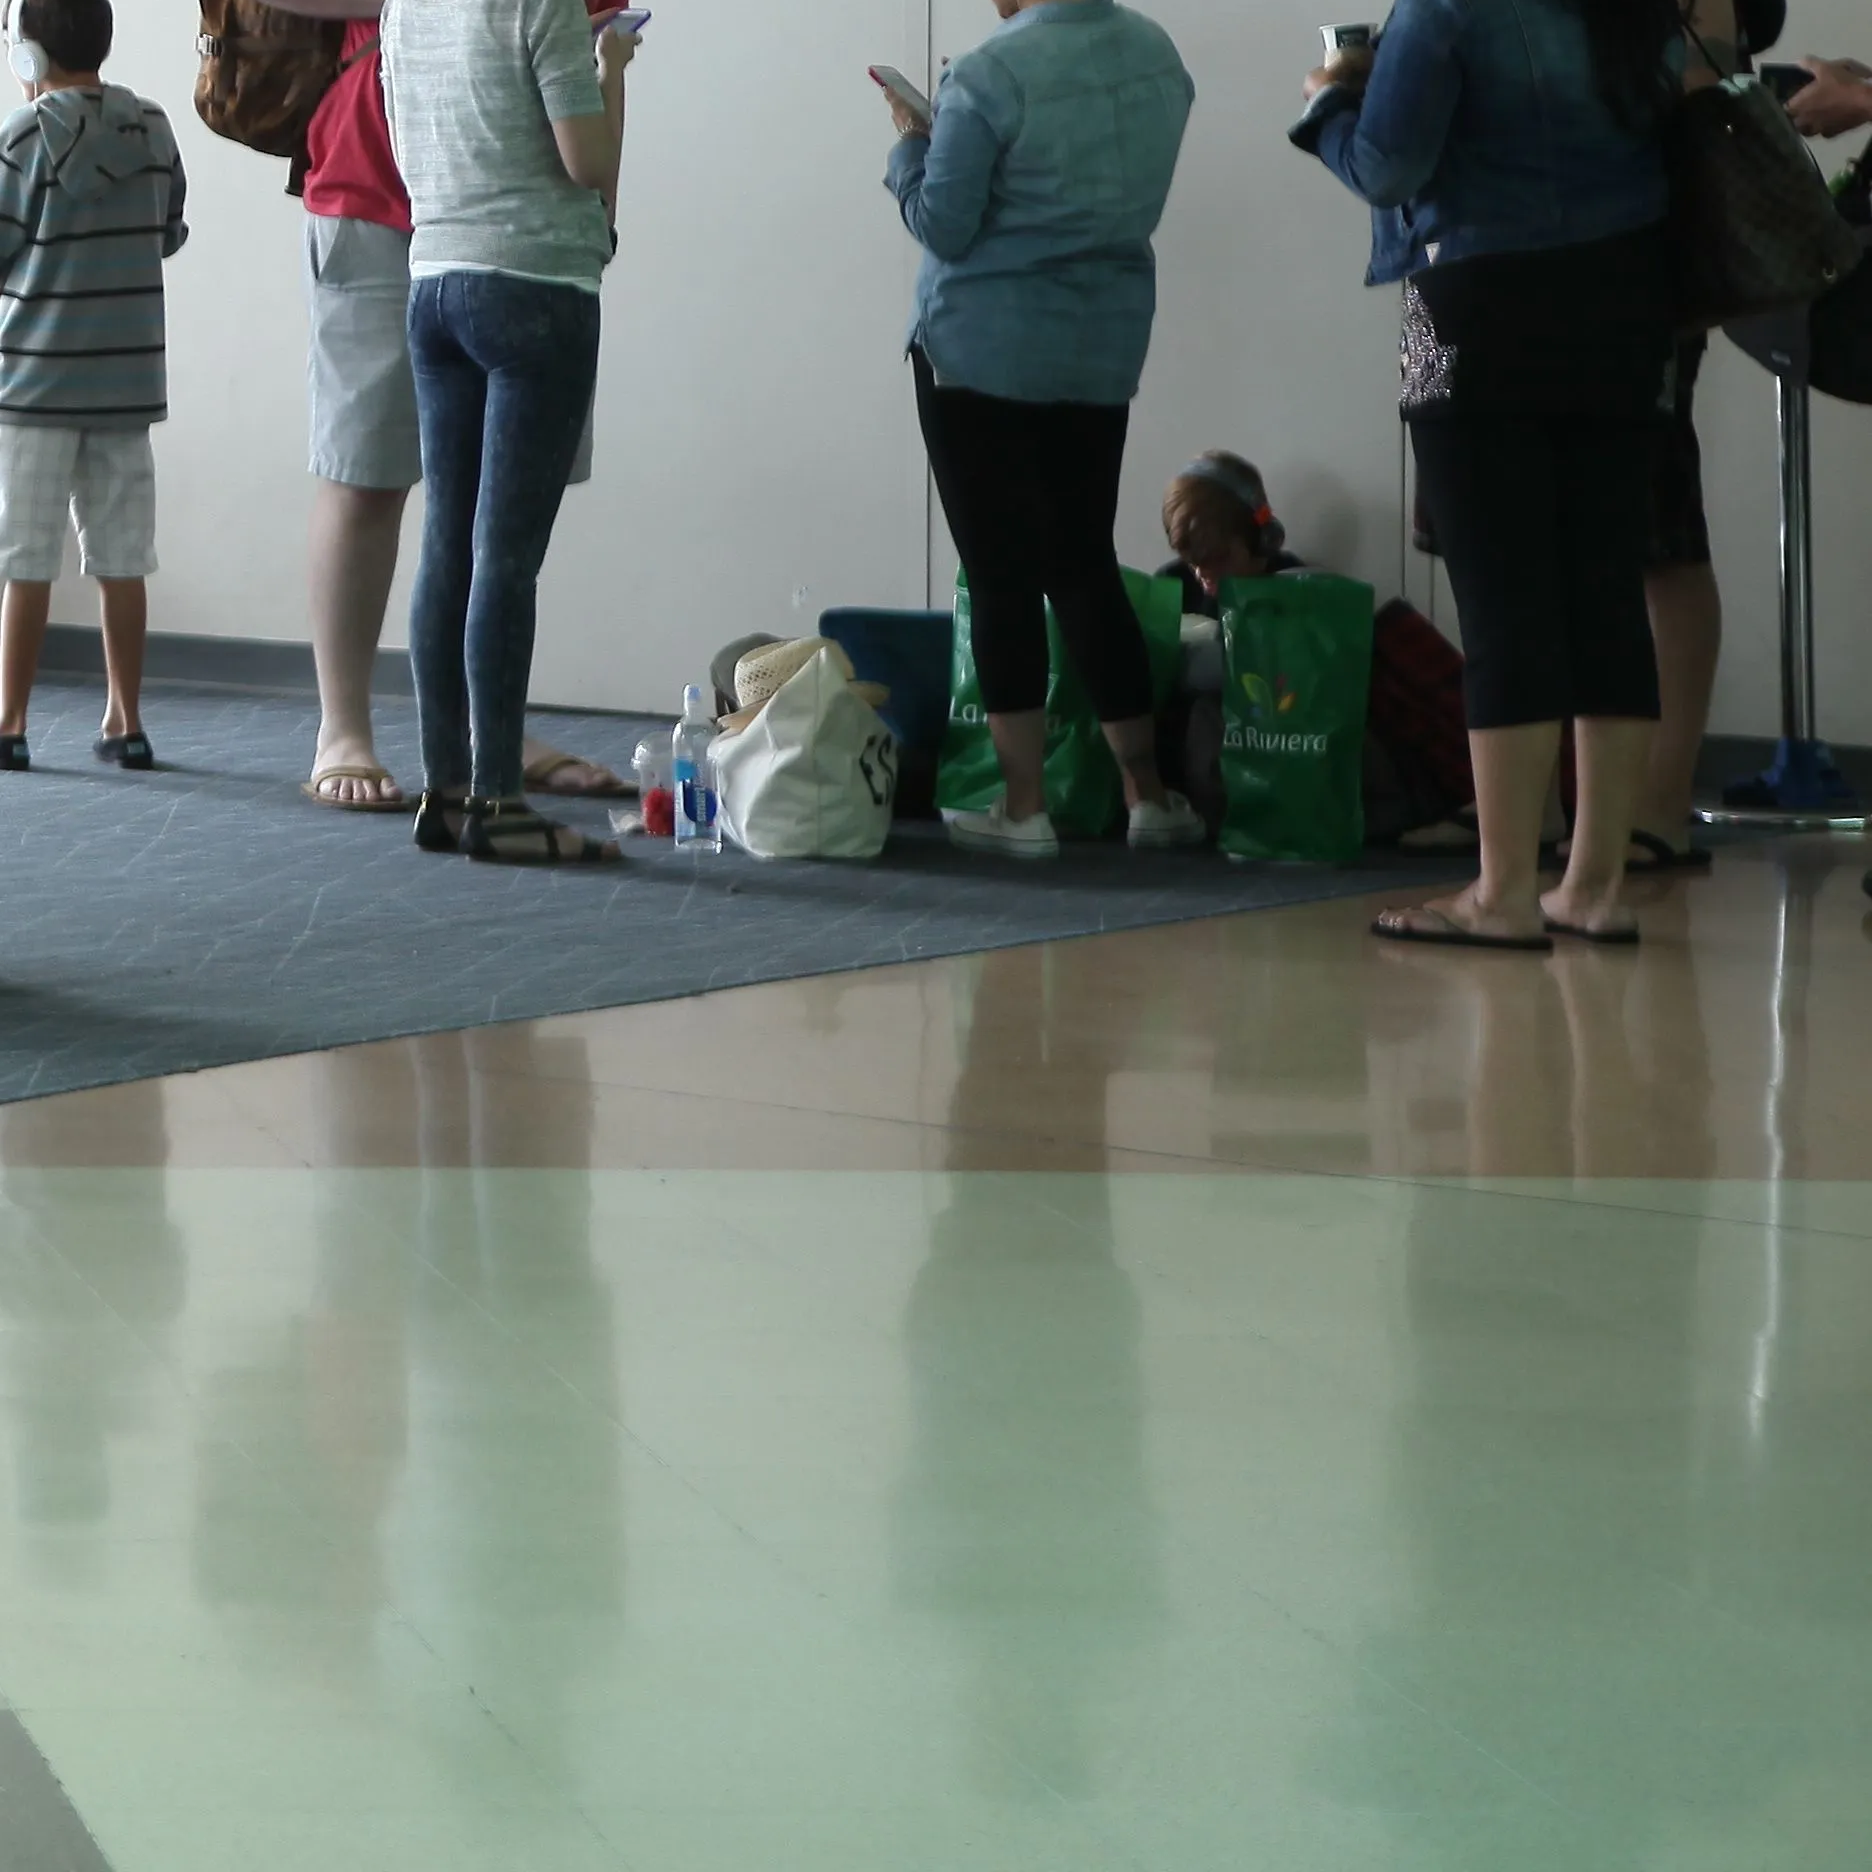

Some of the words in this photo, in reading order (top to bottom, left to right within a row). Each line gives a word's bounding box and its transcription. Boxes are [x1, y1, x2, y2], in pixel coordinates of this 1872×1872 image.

[948, 695, 978, 724] La
[1223, 723, 1243, 747] La
[1245, 726, 1328, 753] Riviera
